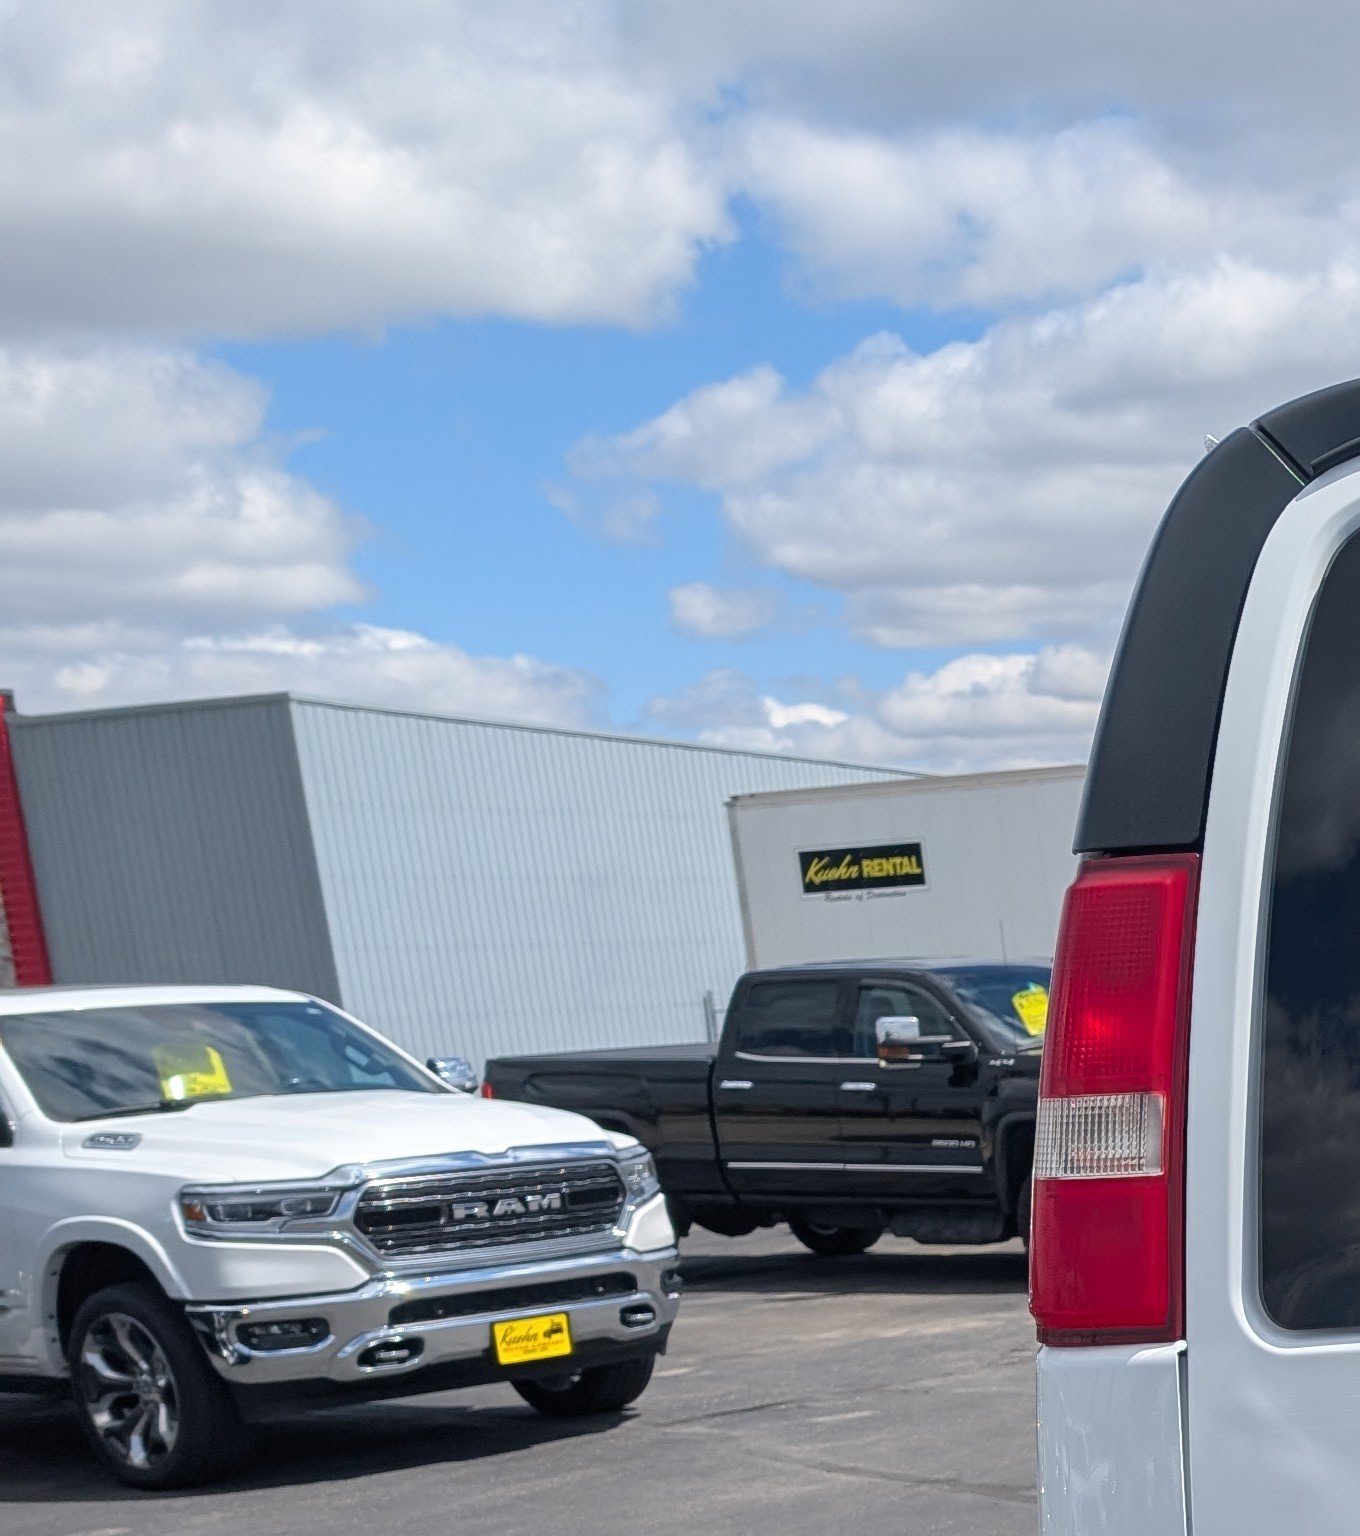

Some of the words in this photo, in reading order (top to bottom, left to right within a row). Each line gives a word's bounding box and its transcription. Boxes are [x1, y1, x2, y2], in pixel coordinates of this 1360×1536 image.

[804, 853, 860, 886] Kuehn
[861, 855, 922, 878] RENTAL
[452, 1192, 562, 1220] RAM
